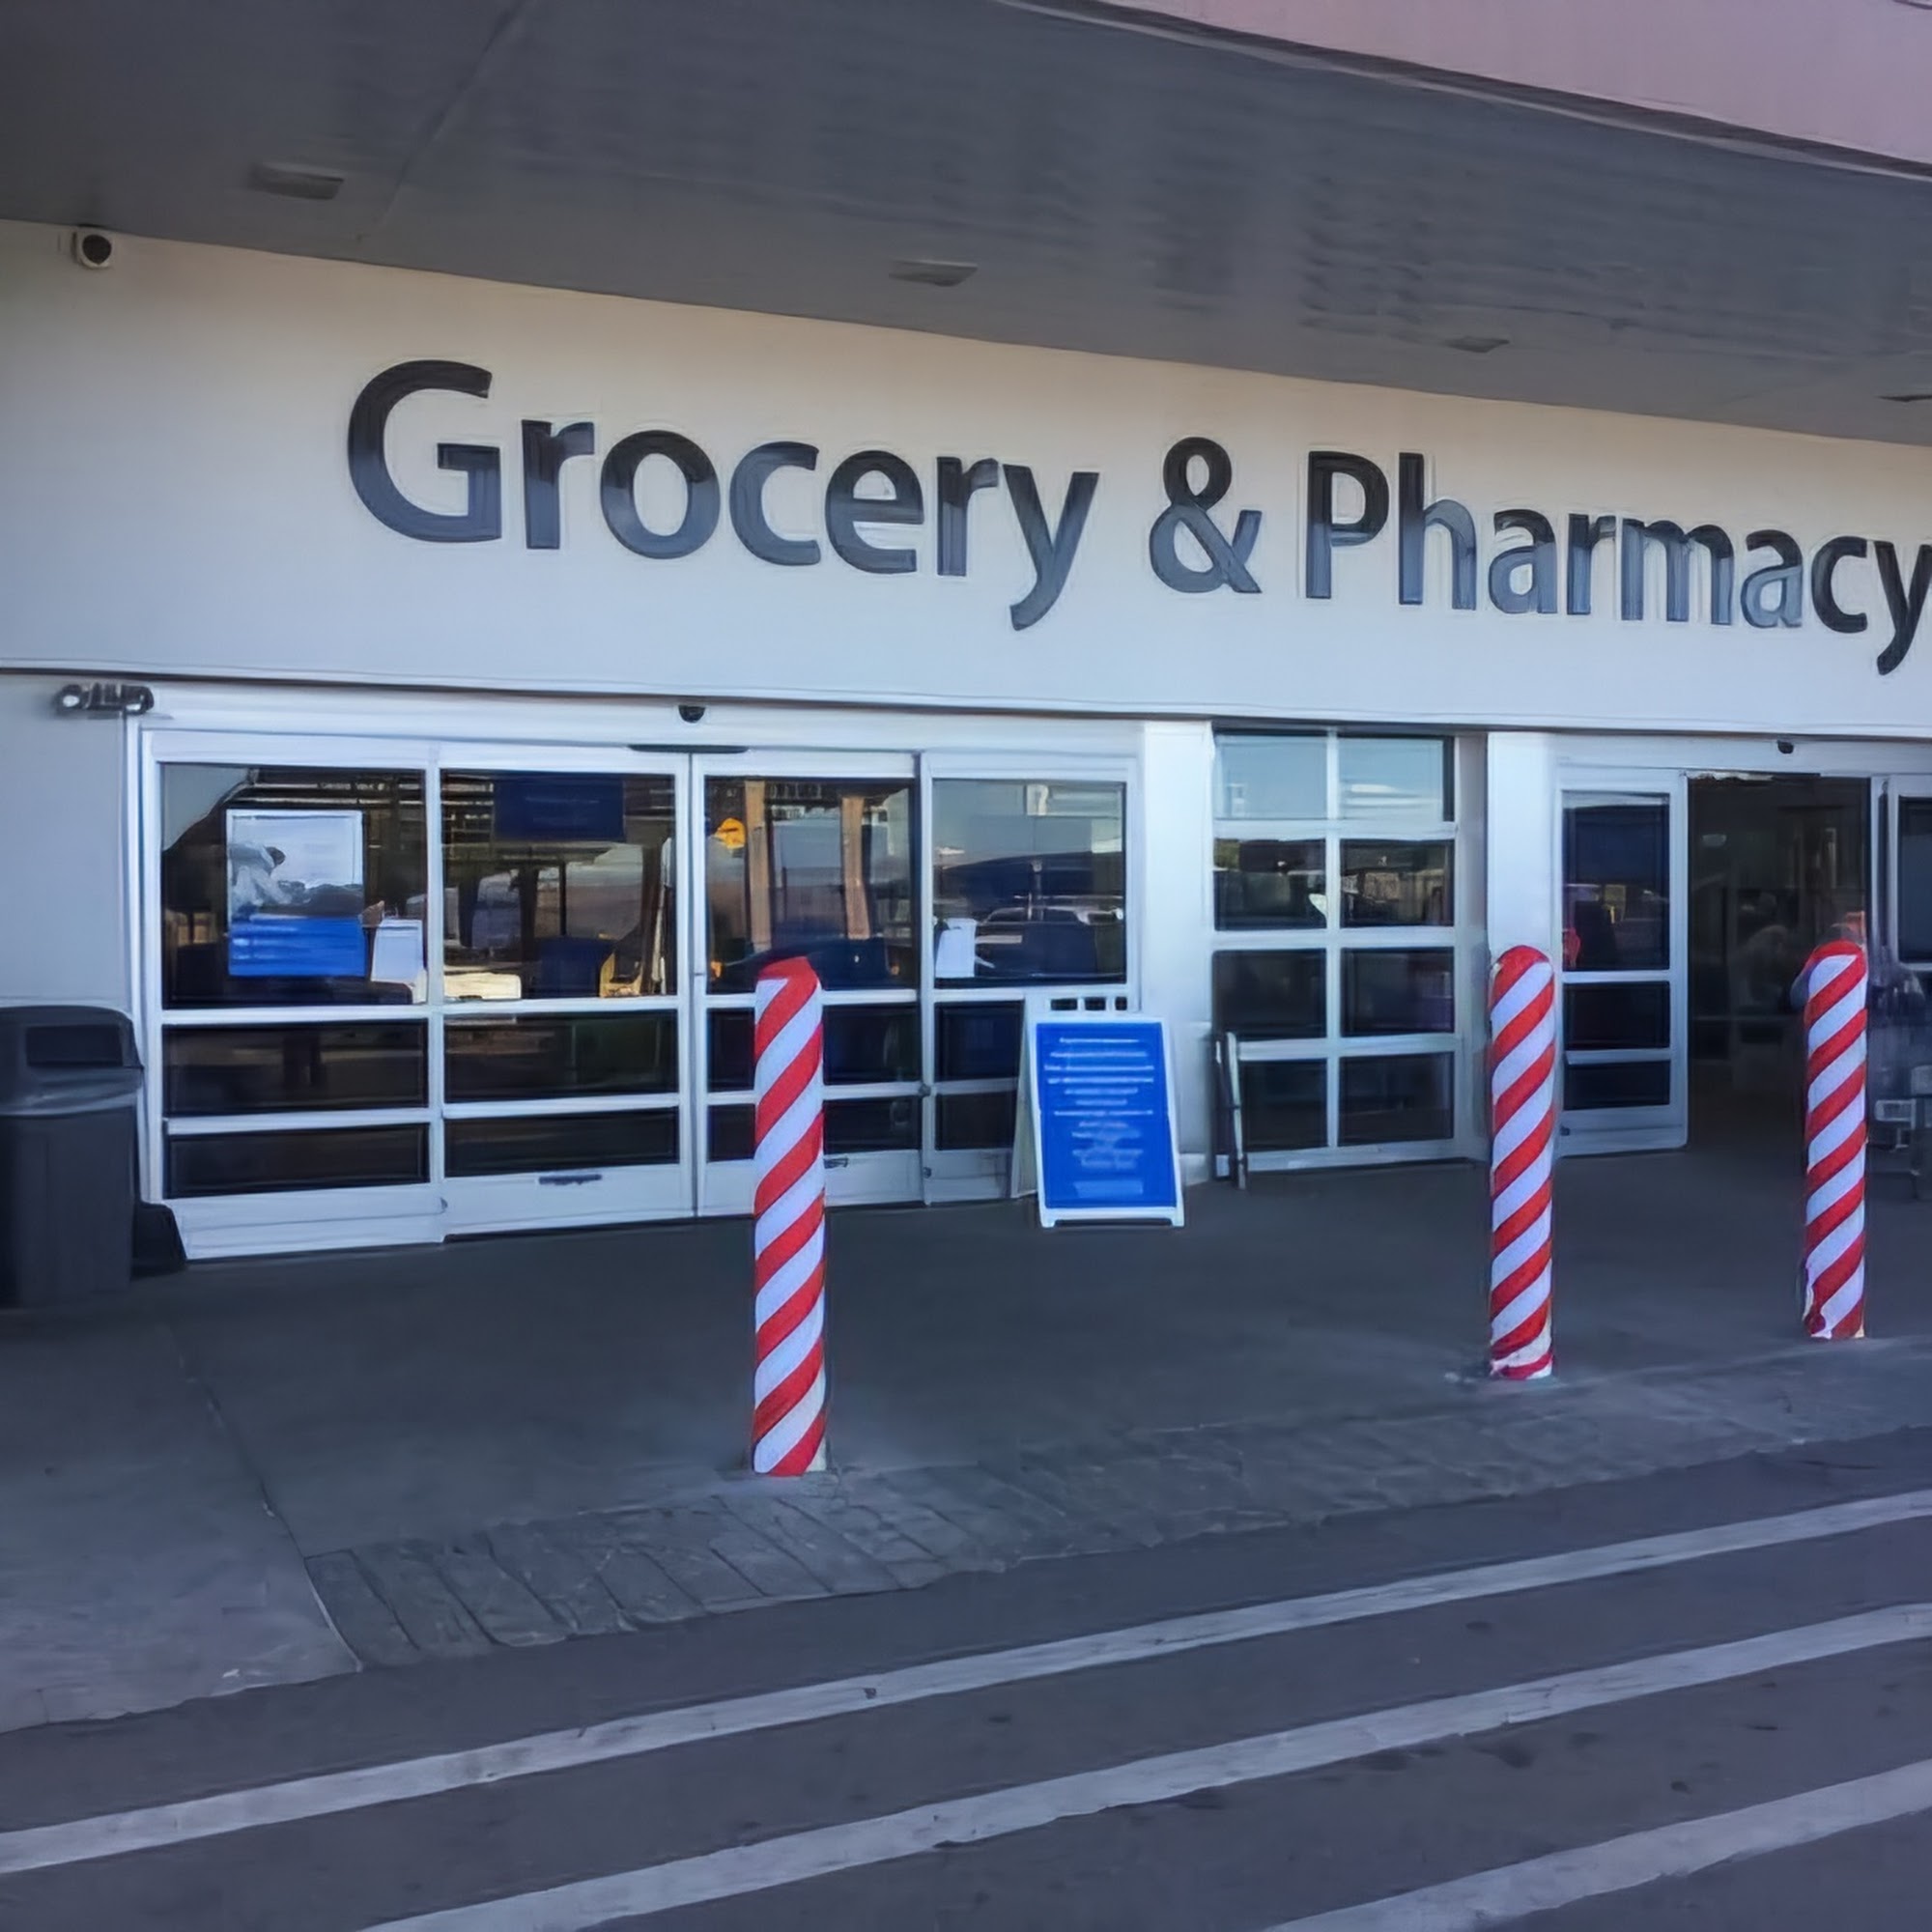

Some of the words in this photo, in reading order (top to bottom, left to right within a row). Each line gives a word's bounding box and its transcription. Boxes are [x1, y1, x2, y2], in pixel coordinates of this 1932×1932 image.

[347, 359, 1099, 632] Grocery
[1149, 437, 1263, 594] &
[1305, 450, 1932, 675] Pharmacy
